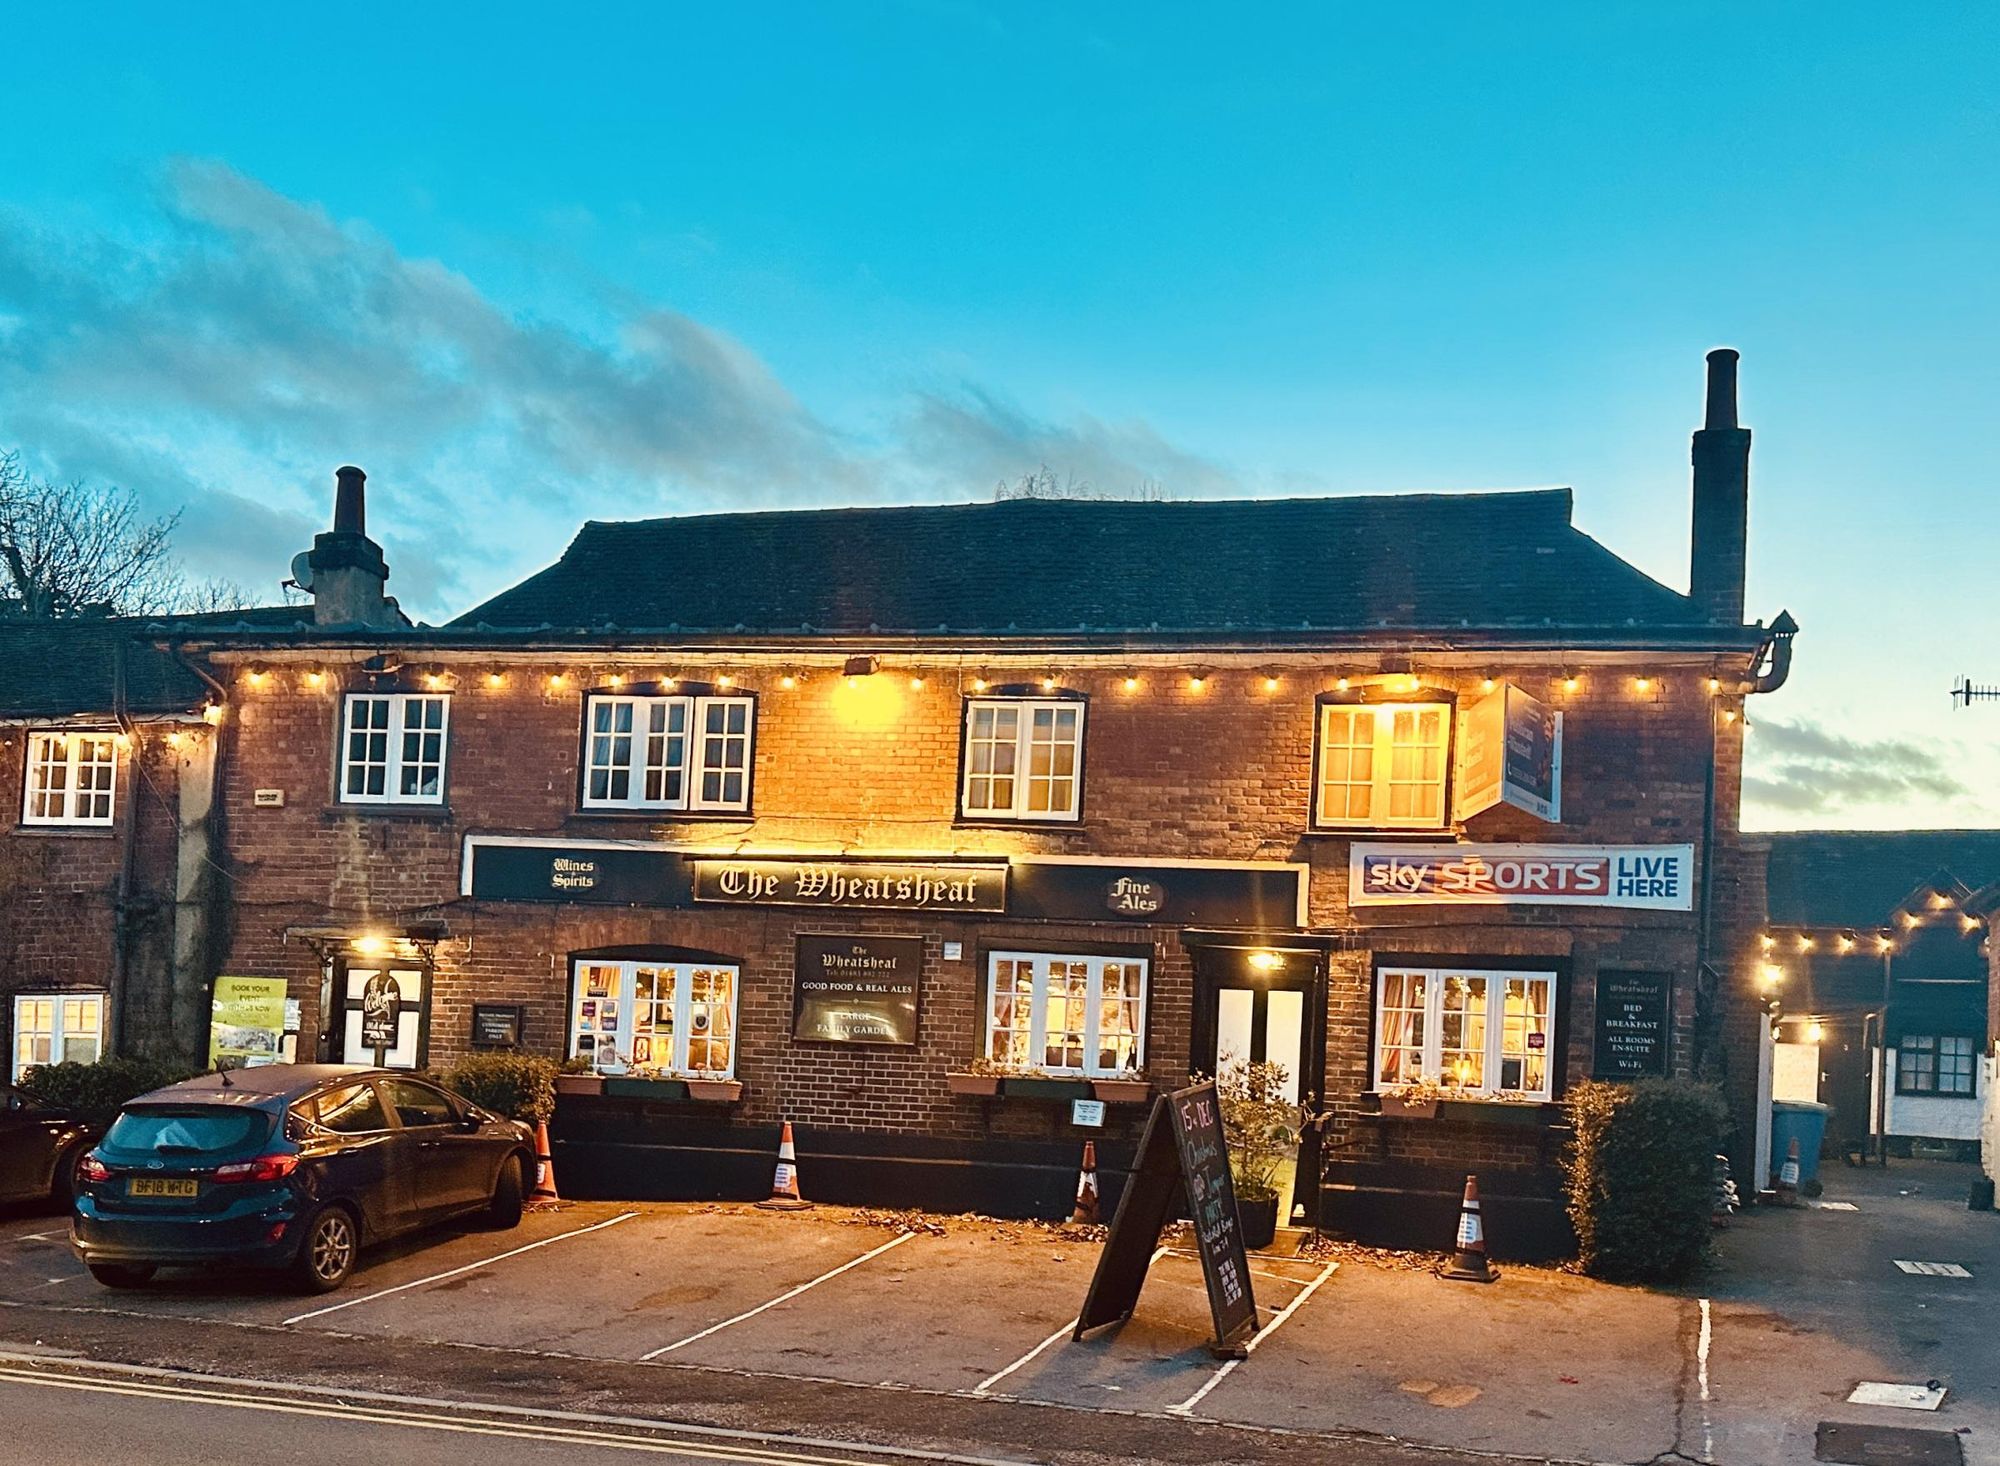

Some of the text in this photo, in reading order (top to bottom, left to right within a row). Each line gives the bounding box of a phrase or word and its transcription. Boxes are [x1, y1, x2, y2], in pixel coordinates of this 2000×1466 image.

[553, 858, 594, 871] Wines
[552, 873, 594, 889] Spirits
[1371, 857, 1679, 892] sky SPORTS LIVE
[718, 866, 977, 905] The Wheatsheaf
[1110, 877, 1151, 897] Fine
[1617, 878, 1679, 898] HERE
[1117, 894, 1157, 911] Ales
[852, 946, 867, 955] The
[822, 954, 897, 969] Wheatsheaf
[231, 984, 250, 992] BOOK
[802, 982, 828, 990] GOOD
[830, 983, 854, 991] FOOD
[865, 984, 888, 992] REAL
[891, 985, 912, 993] ALES
[1623, 1004, 1643, 1012] BED
[853, 1026, 895, 1035] GARDE
[1606, 1019, 1659, 1029] BREAKFAST
[1607, 1035, 1656, 1044] ALL ROOMS
[1612, 1044, 1650, 1053] EN-SUITE
[1196, 1100, 1214, 1128] DEC
